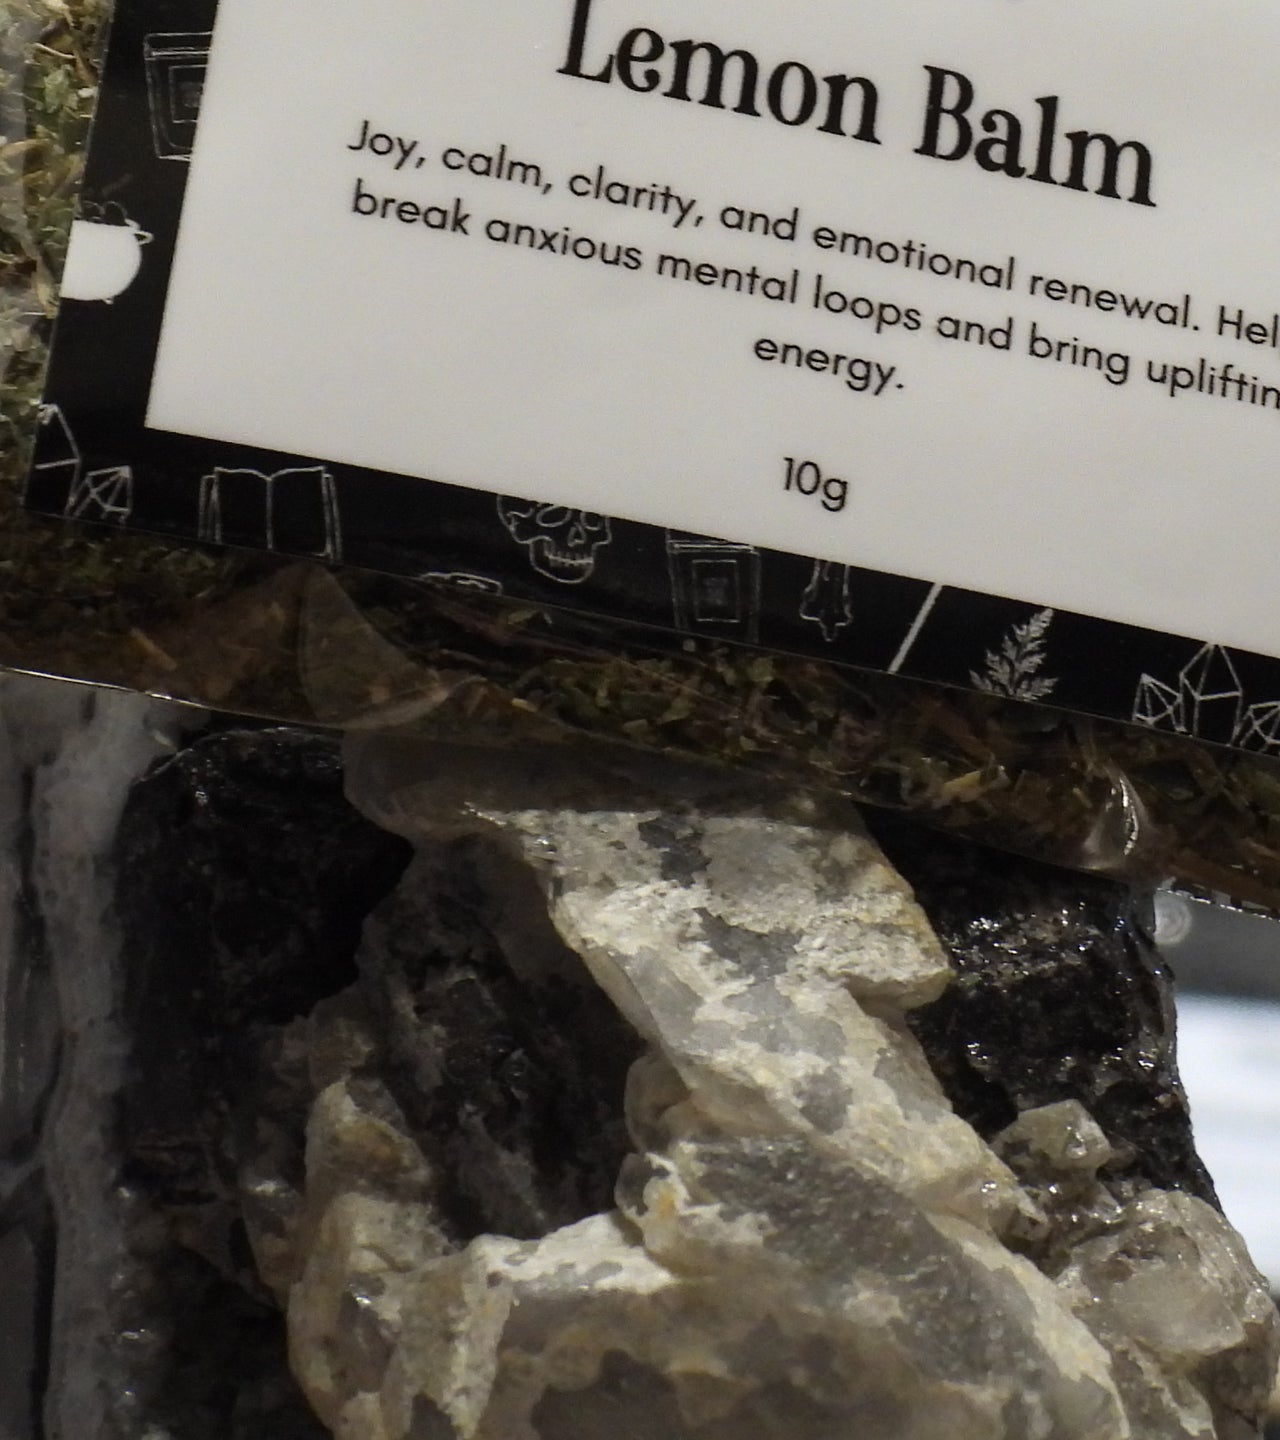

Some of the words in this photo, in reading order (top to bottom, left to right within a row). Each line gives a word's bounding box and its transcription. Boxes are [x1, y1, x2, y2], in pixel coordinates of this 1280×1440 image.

[914, 65, 1159, 207] Balm
[347, 120, 427, 170] Joy,
[442, 144, 553, 196] calm,
[568, 164, 705, 228] clarity,
[719, 206, 800, 243] and
[812, 227, 1016, 291] emotional
[1029, 274, 1200, 332] renewal.
[351, 178, 472, 236] break
[484, 219, 644, 271] anxious
[657, 253, 800, 305] mental
[813, 274, 922, 335] loops
[935, 315, 1014, 352] and
[1028, 322, 1131, 387] bring
[753, 337, 905, 397] energy.
[782, 456, 850, 514] 10g
